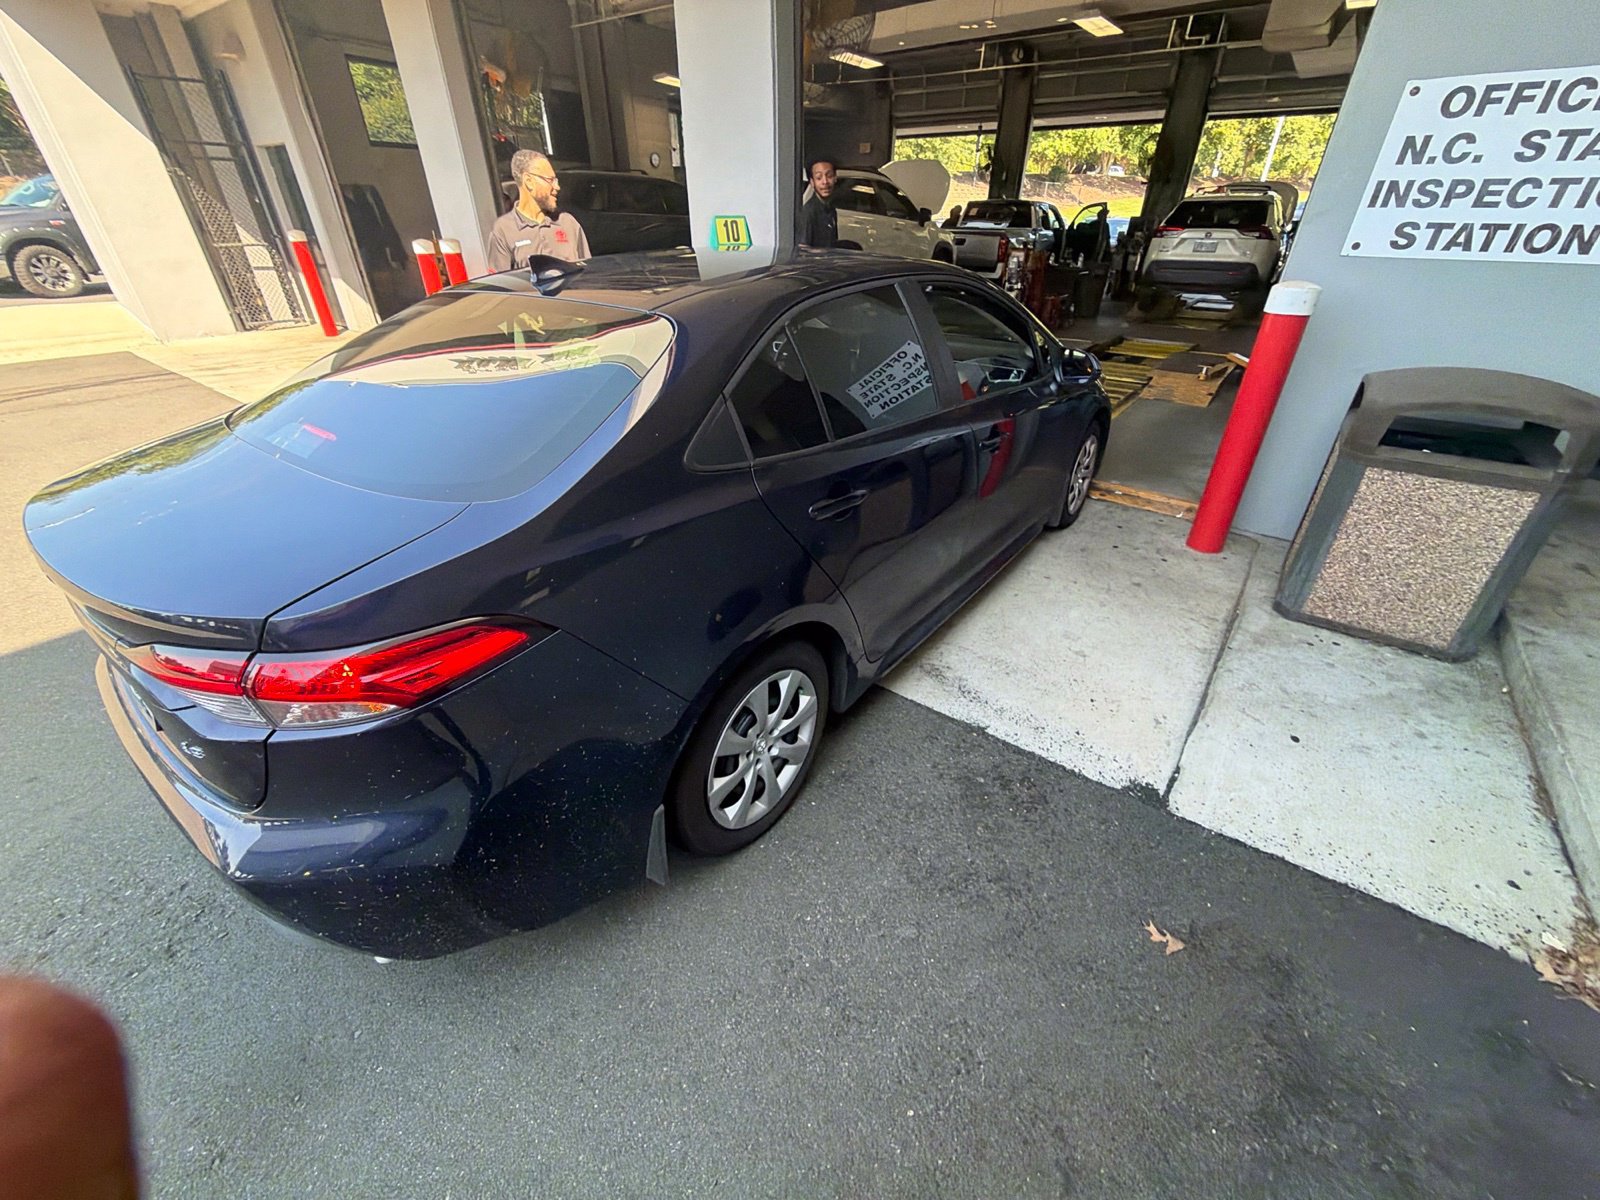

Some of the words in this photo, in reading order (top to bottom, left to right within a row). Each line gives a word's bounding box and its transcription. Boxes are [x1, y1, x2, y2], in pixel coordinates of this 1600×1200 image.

[1440, 77, 1600, 119] OFFIC
[1395, 132, 1484, 165] N.C.
[1367, 177, 1600, 209] INSPECTI
[723, 219, 740, 242] 10
[1389, 221, 1600, 255] STATION
